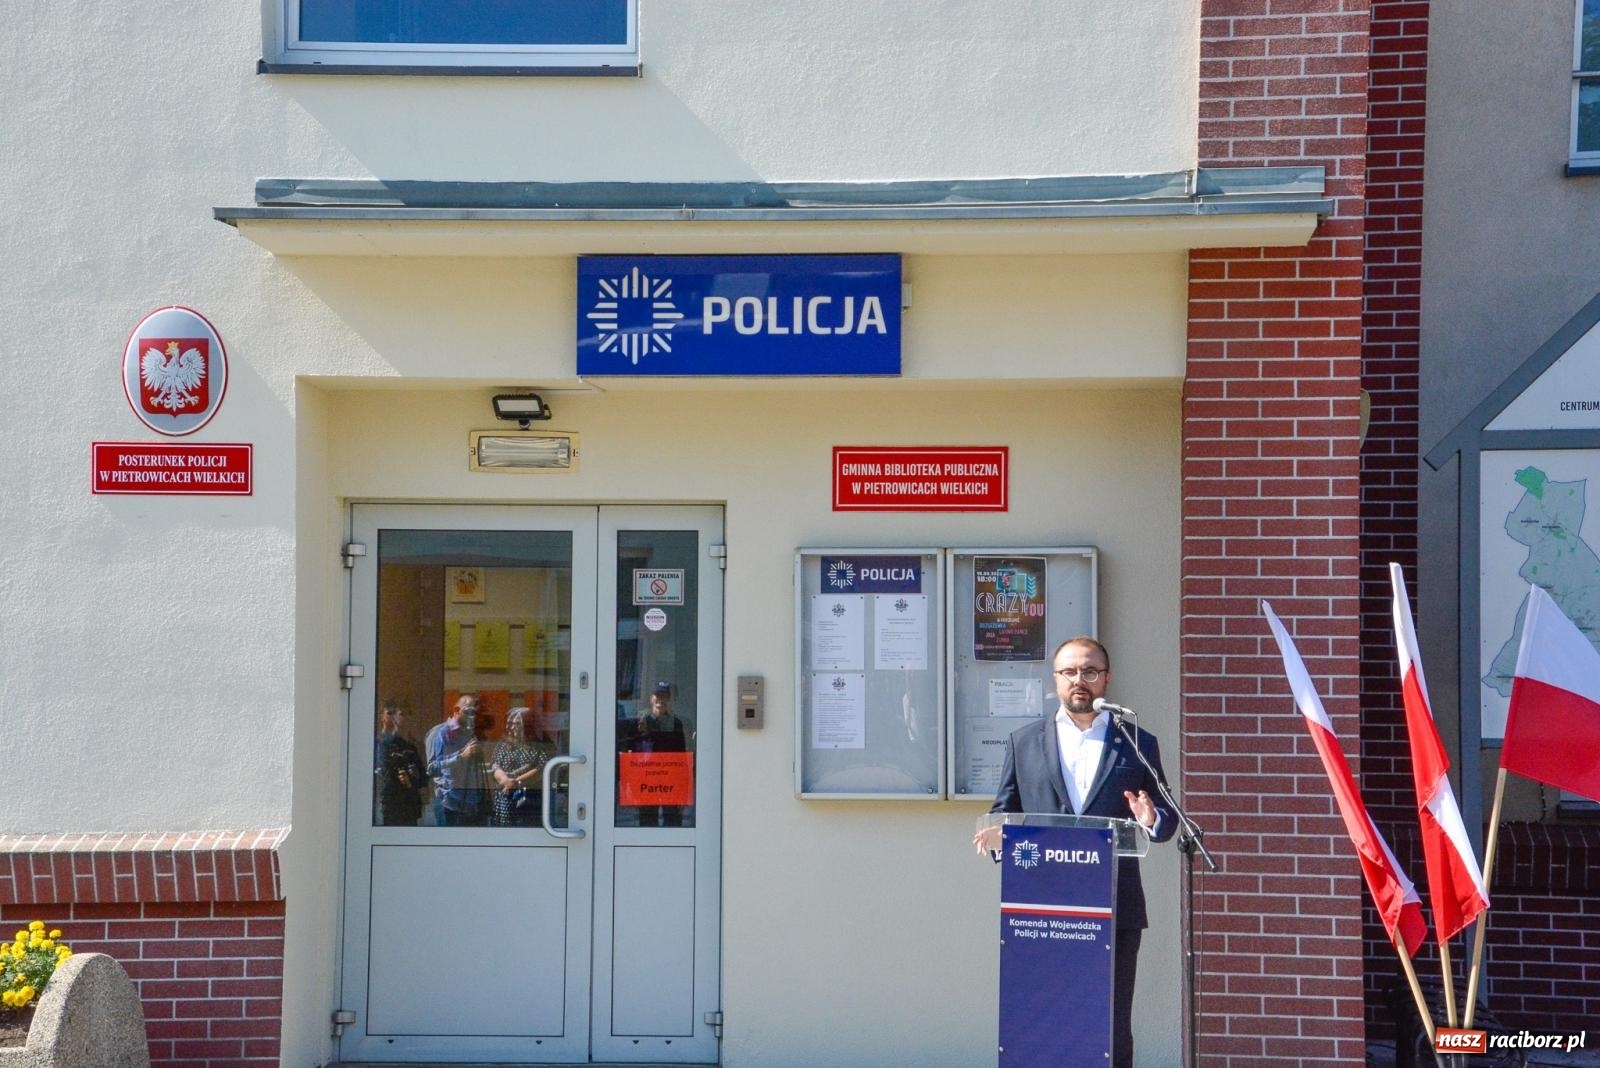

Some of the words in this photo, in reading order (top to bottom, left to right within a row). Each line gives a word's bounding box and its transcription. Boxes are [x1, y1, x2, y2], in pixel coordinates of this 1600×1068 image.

[703, 296, 887, 335] POLICJA
[1560, 401, 1600, 411] CENTRUM
[118, 454, 186, 467] POSTERUNEK
[187, 455, 227, 468] POLICJI
[842, 463, 882, 476] GMINNA
[884, 463, 941, 476] BIBLIOTEKA
[944, 463, 999, 476] PUBLICZNA
[99, 470, 110, 482] W
[112, 471, 191, 483] PIETROWICACH
[192, 472, 246, 484] WIELKICH
[851, 482, 862, 495] W
[863, 482, 937, 495] PIETROWICACH
[940, 482, 989, 495] WIELKICH
[860, 568, 915, 581] POLICJA
[975, 592, 1028, 613] CRAZY
[640, 783, 674, 793] Parter
[1045, 849, 1100, 864] POLICJA
[1009, 918, 1048, 928] Komenda
[1049, 920, 1101, 930] Wojewódzka
[1014, 929, 1038, 939] Policji
[1049, 931, 1096, 941] Katowicach
